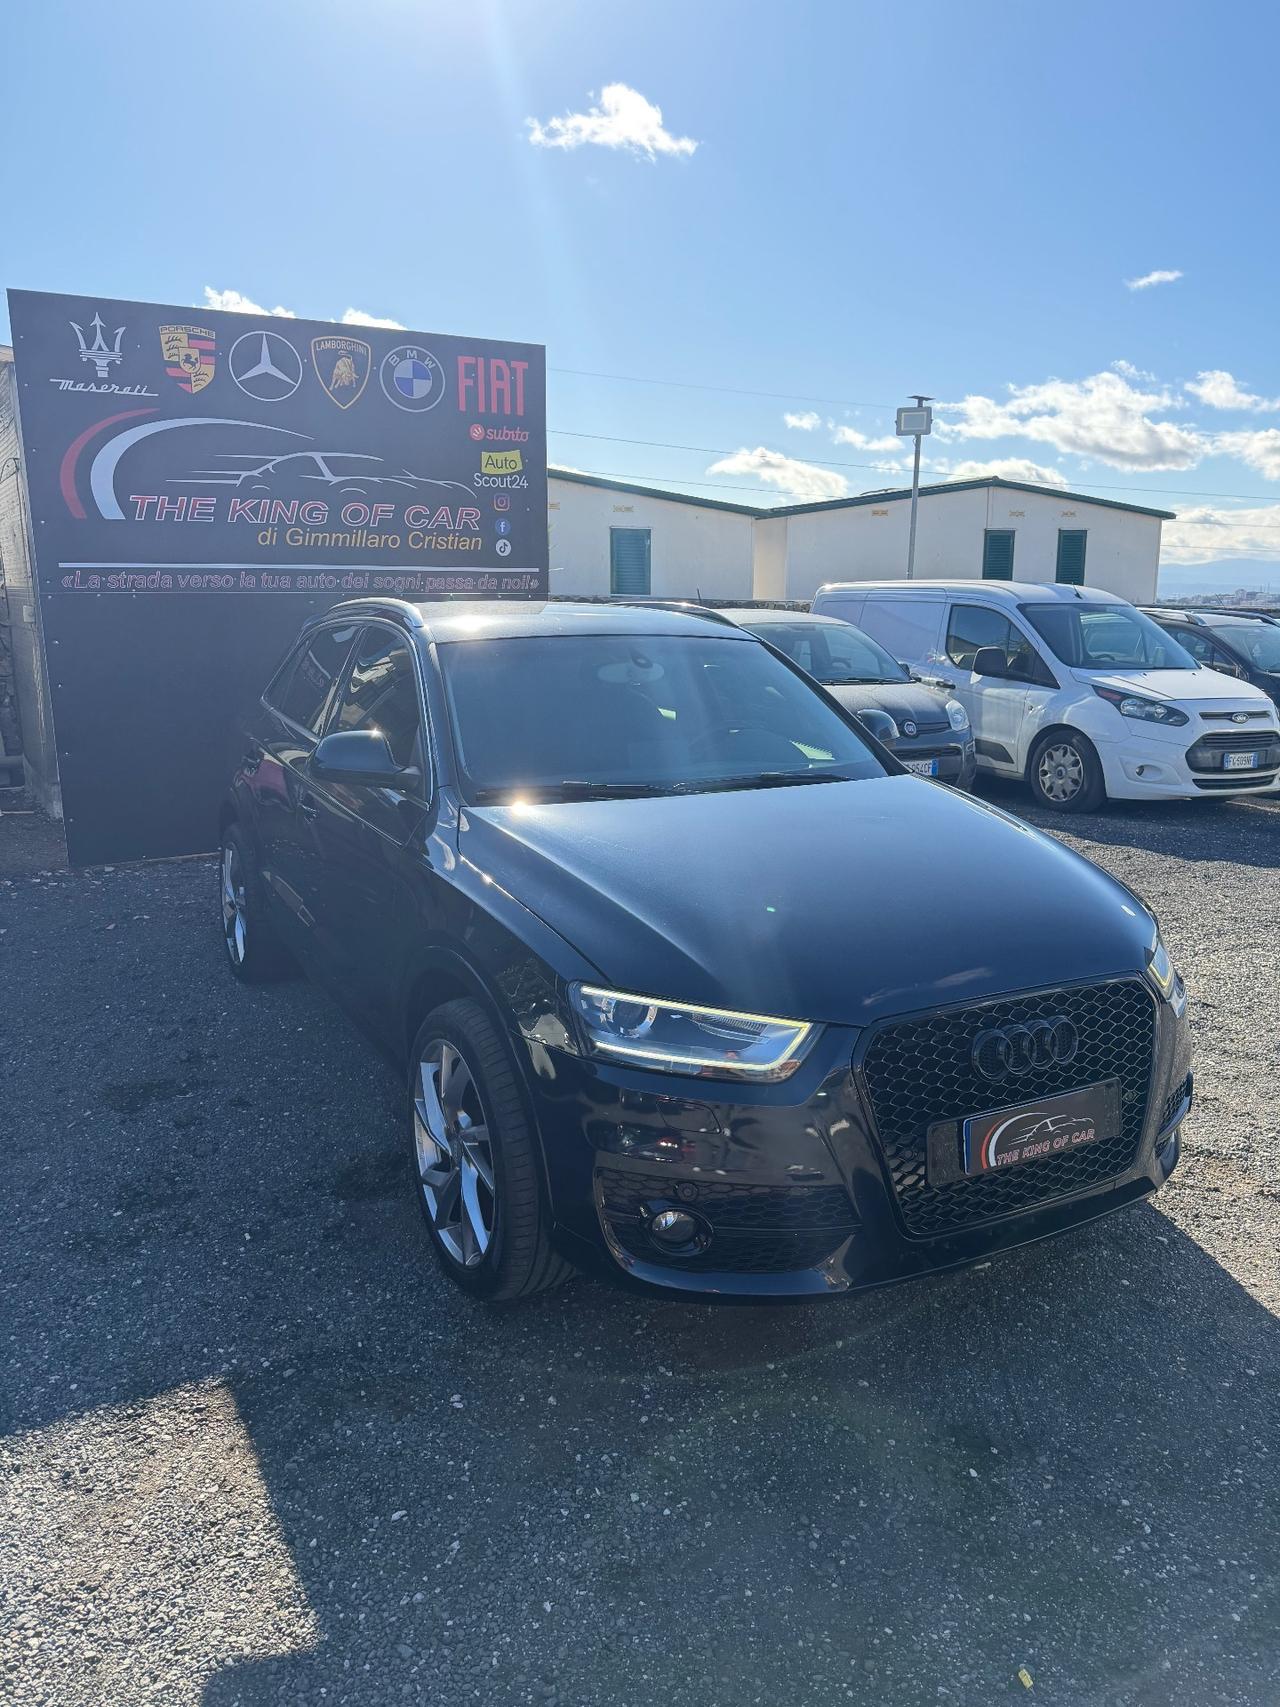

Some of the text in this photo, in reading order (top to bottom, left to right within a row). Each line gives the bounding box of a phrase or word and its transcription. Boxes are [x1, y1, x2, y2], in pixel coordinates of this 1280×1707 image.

[160, 325, 216, 338] PORSCHE
[316, 339, 368, 356] LAMBORGHINI
[388, 349, 436, 369] BMW
[50, 378, 159, 397] Maserati
[457, 355, 529, 416] FIAT
[486, 425, 530, 442] subito
[484, 454, 518, 471] Auto
[473, 472, 529, 489] Scout24
[130, 495, 481, 531] THE KING OF CAR
[257, 527, 483, 551] di Gimmillaro Cristian
[107, 571, 173, 589] strada
[177, 574, 235, 589] verso
[239, 572, 256, 589] la
[260, 572, 291, 589] tua
[296, 572, 338, 589] auto
[341, 572, 370, 590] dei
[373, 573, 421, 592] sogni
[425, 575, 475, 592] passa
[477, 574, 498, 590] da
[996, 1128, 1096, 1166] THE KING OF CAR
